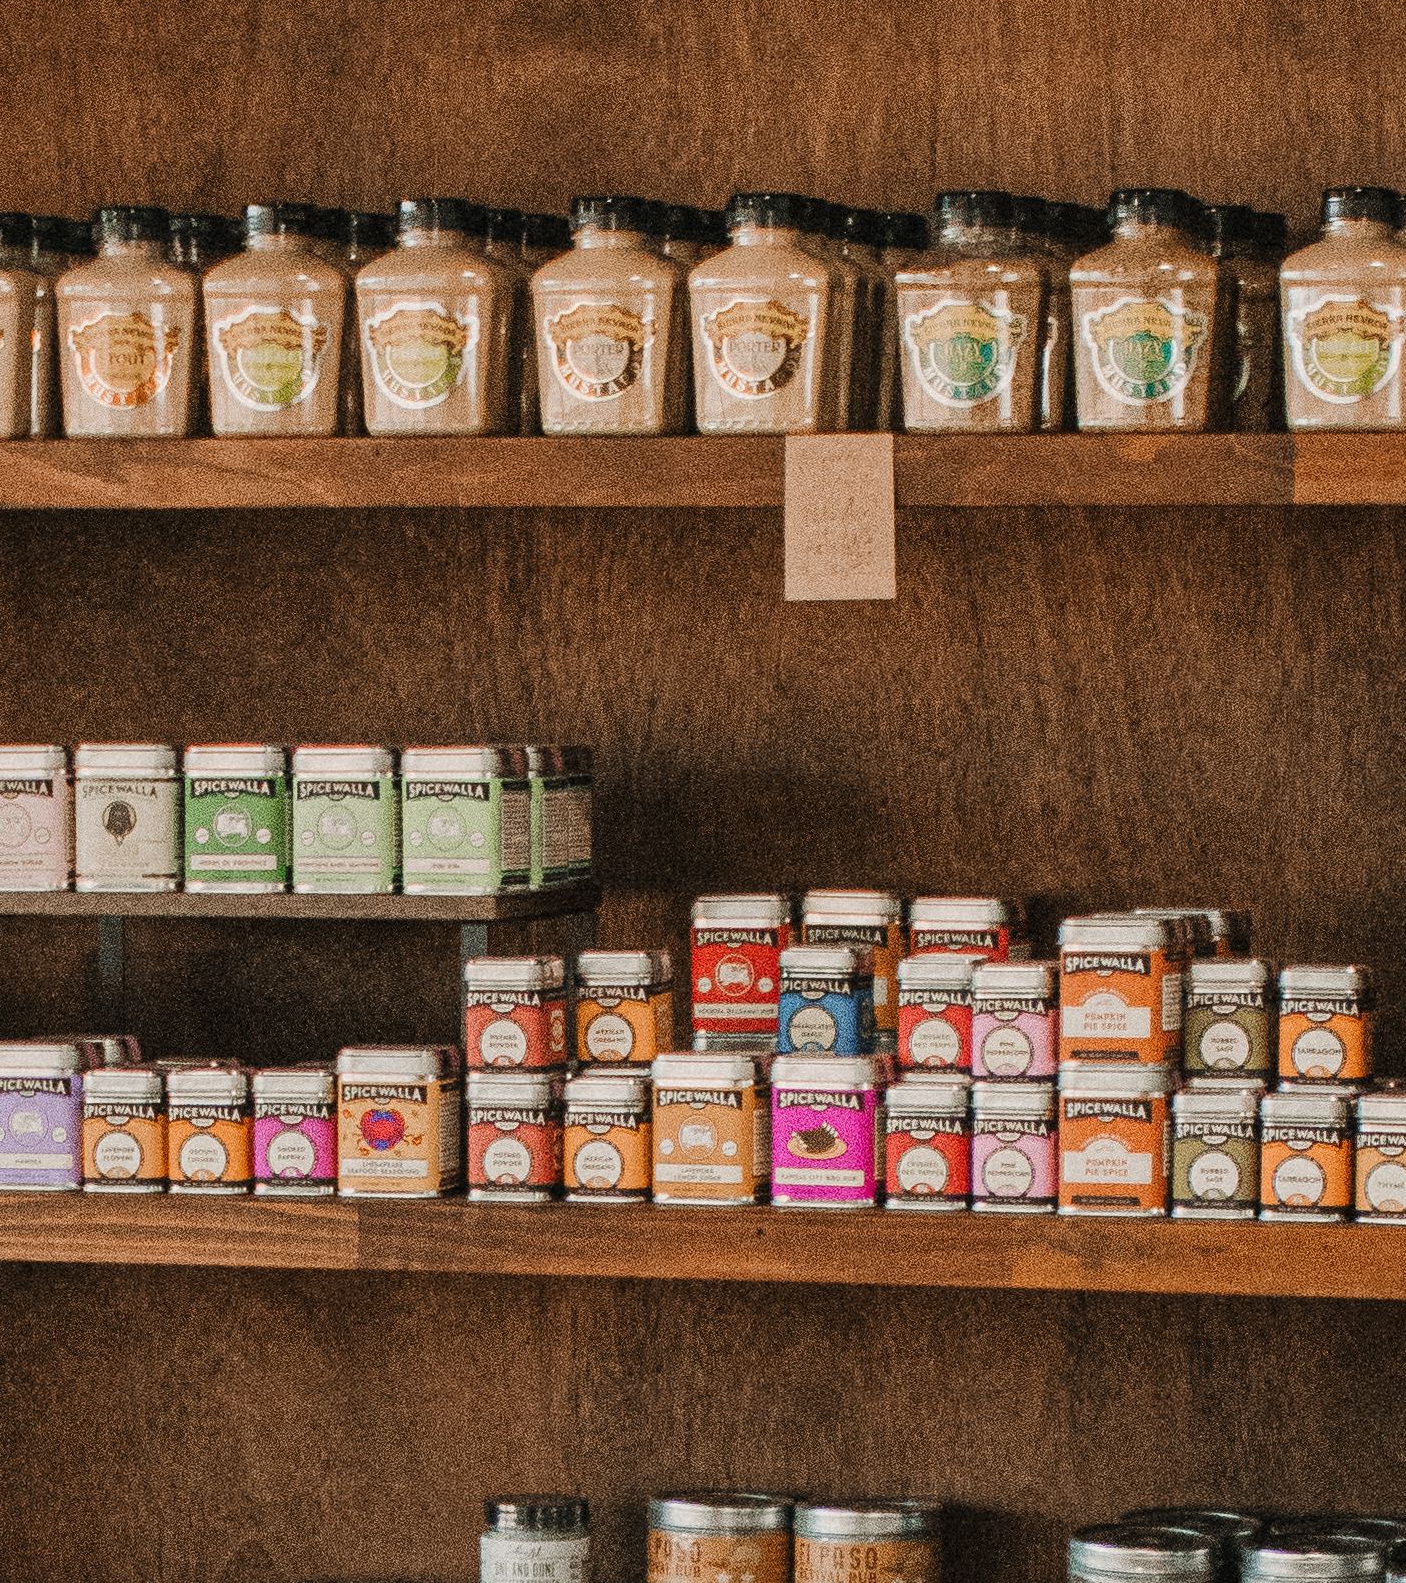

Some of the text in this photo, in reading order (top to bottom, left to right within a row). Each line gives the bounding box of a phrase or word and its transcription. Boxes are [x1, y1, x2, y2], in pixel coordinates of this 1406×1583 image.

[193, 780, 272, 797] SPICEWALLA
[297, 782, 377, 799] SPICEWALLA
[407, 783, 486, 800] SPICEWALLA
[696, 931, 773, 946] SPICEWALLA
[917, 933, 993, 947] SPICEWALLA
[1065, 955, 1146, 974] SPICEWALLA
[467, 992, 541, 1007] SPICEWALLA
[344, 1086, 423, 1102] SPICEWALLA
[659, 1091, 737, 1106] SPICEWALLA
[779, 1091, 860, 1109] SPICEWALLA
[1066, 1101, 1148, 1120] SPICEWALLA
[1262, 1127, 1340, 1145] SPICEWALLA
